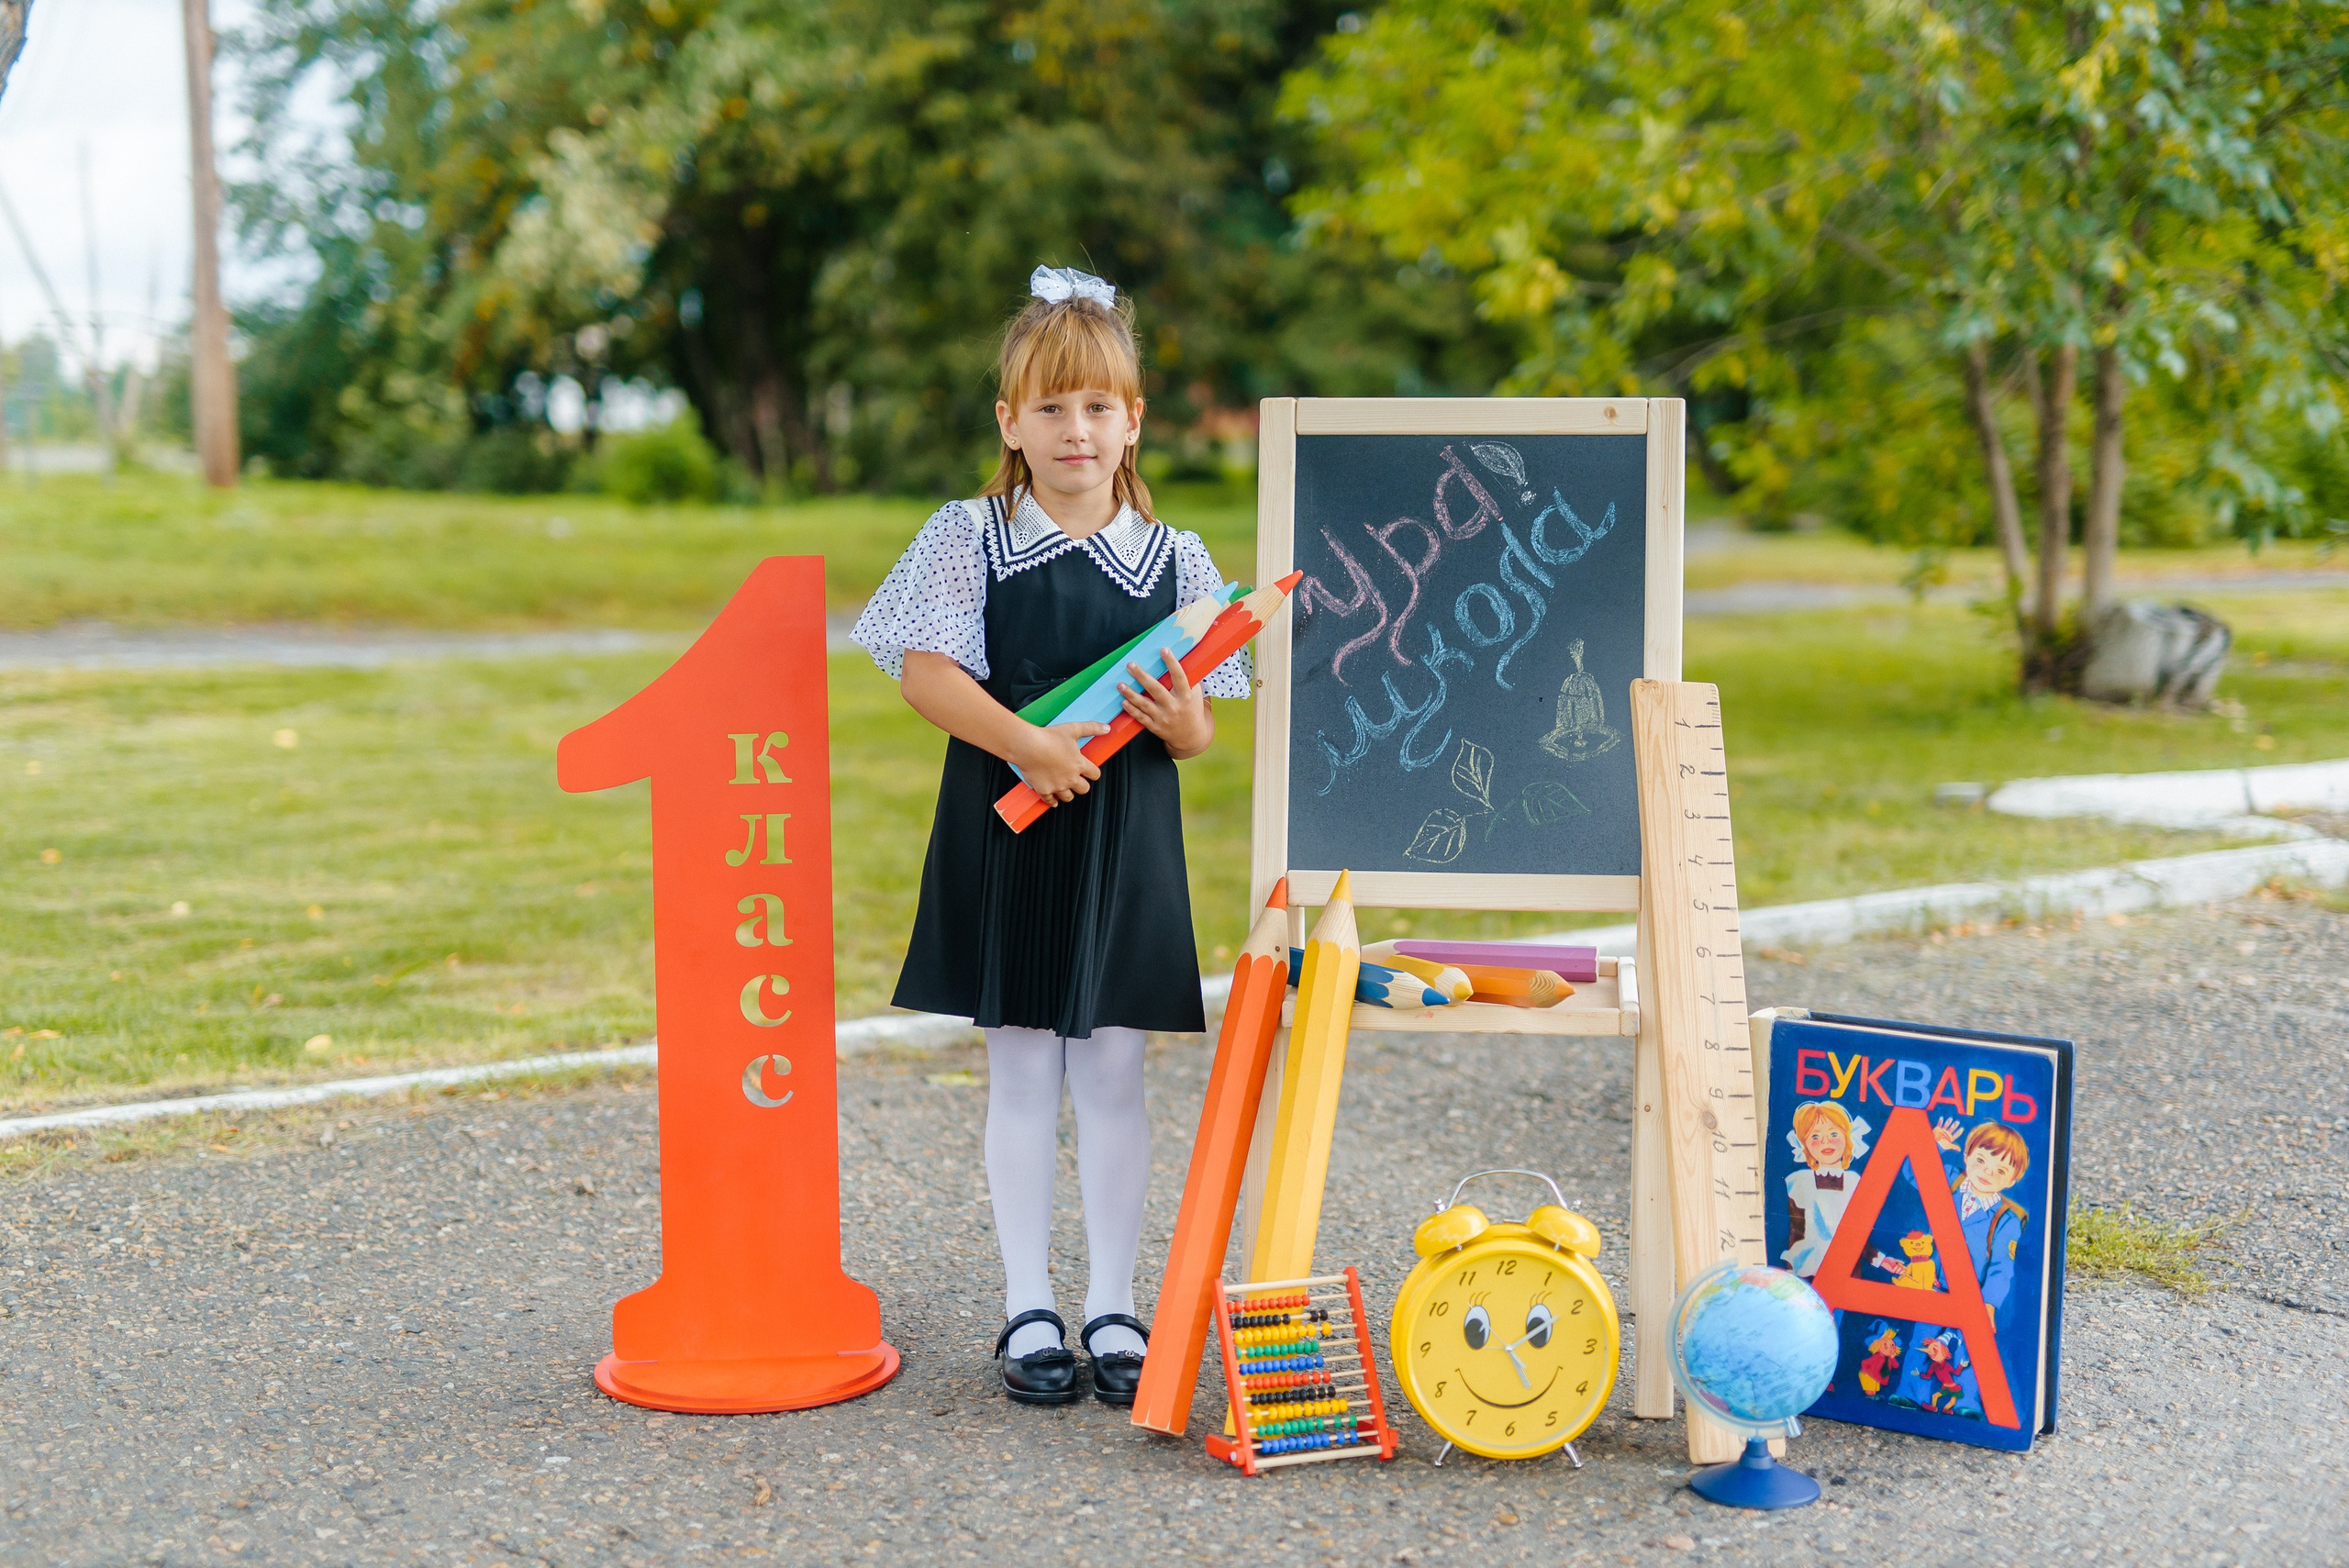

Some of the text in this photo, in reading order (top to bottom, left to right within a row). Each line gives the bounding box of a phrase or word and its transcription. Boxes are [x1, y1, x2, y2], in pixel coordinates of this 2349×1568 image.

[1317, 486, 1617, 796] школа
[1675, 718, 1690, 728] 1
[1679, 763, 1696, 779] 2
[1684, 809, 1700, 819] 3
[1688, 855, 1704, 866] 4
[1693, 898, 1709, 913] 5
[1696, 946, 1711, 958] 6
[556, 555, 883, 1367] 1
[1699, 992, 1715, 1005] 7
[1704, 1040, 1720, 1051] 8
[1709, 1087, 1723, 1099] 9
[1795, 1048, 2038, 1124] БУКВАРЬ
[1711, 1130, 1728, 1153] 10
[1714, 1177, 1730, 1200] 11
[1720, 1229, 1736, 1251] 12
[1497, 1260, 1517, 1275] 12
[1459, 1271, 1476, 1286] 11
[1544, 1272, 1553, 1286] 1
[1429, 1301, 1449, 1318] 10
[1571, 1299, 1584, 1315] 2
[1420, 1341, 1431, 1358] 9
[1583, 1339, 1598, 1355] 3
[1435, 1382, 1447, 1397] 8
[1575, 1381, 1588, 1396] 4
[1466, 1410, 1477, 1426] 7
[1545, 1411, 1558, 1427] 5
[1505, 1421, 1515, 1437] 6
